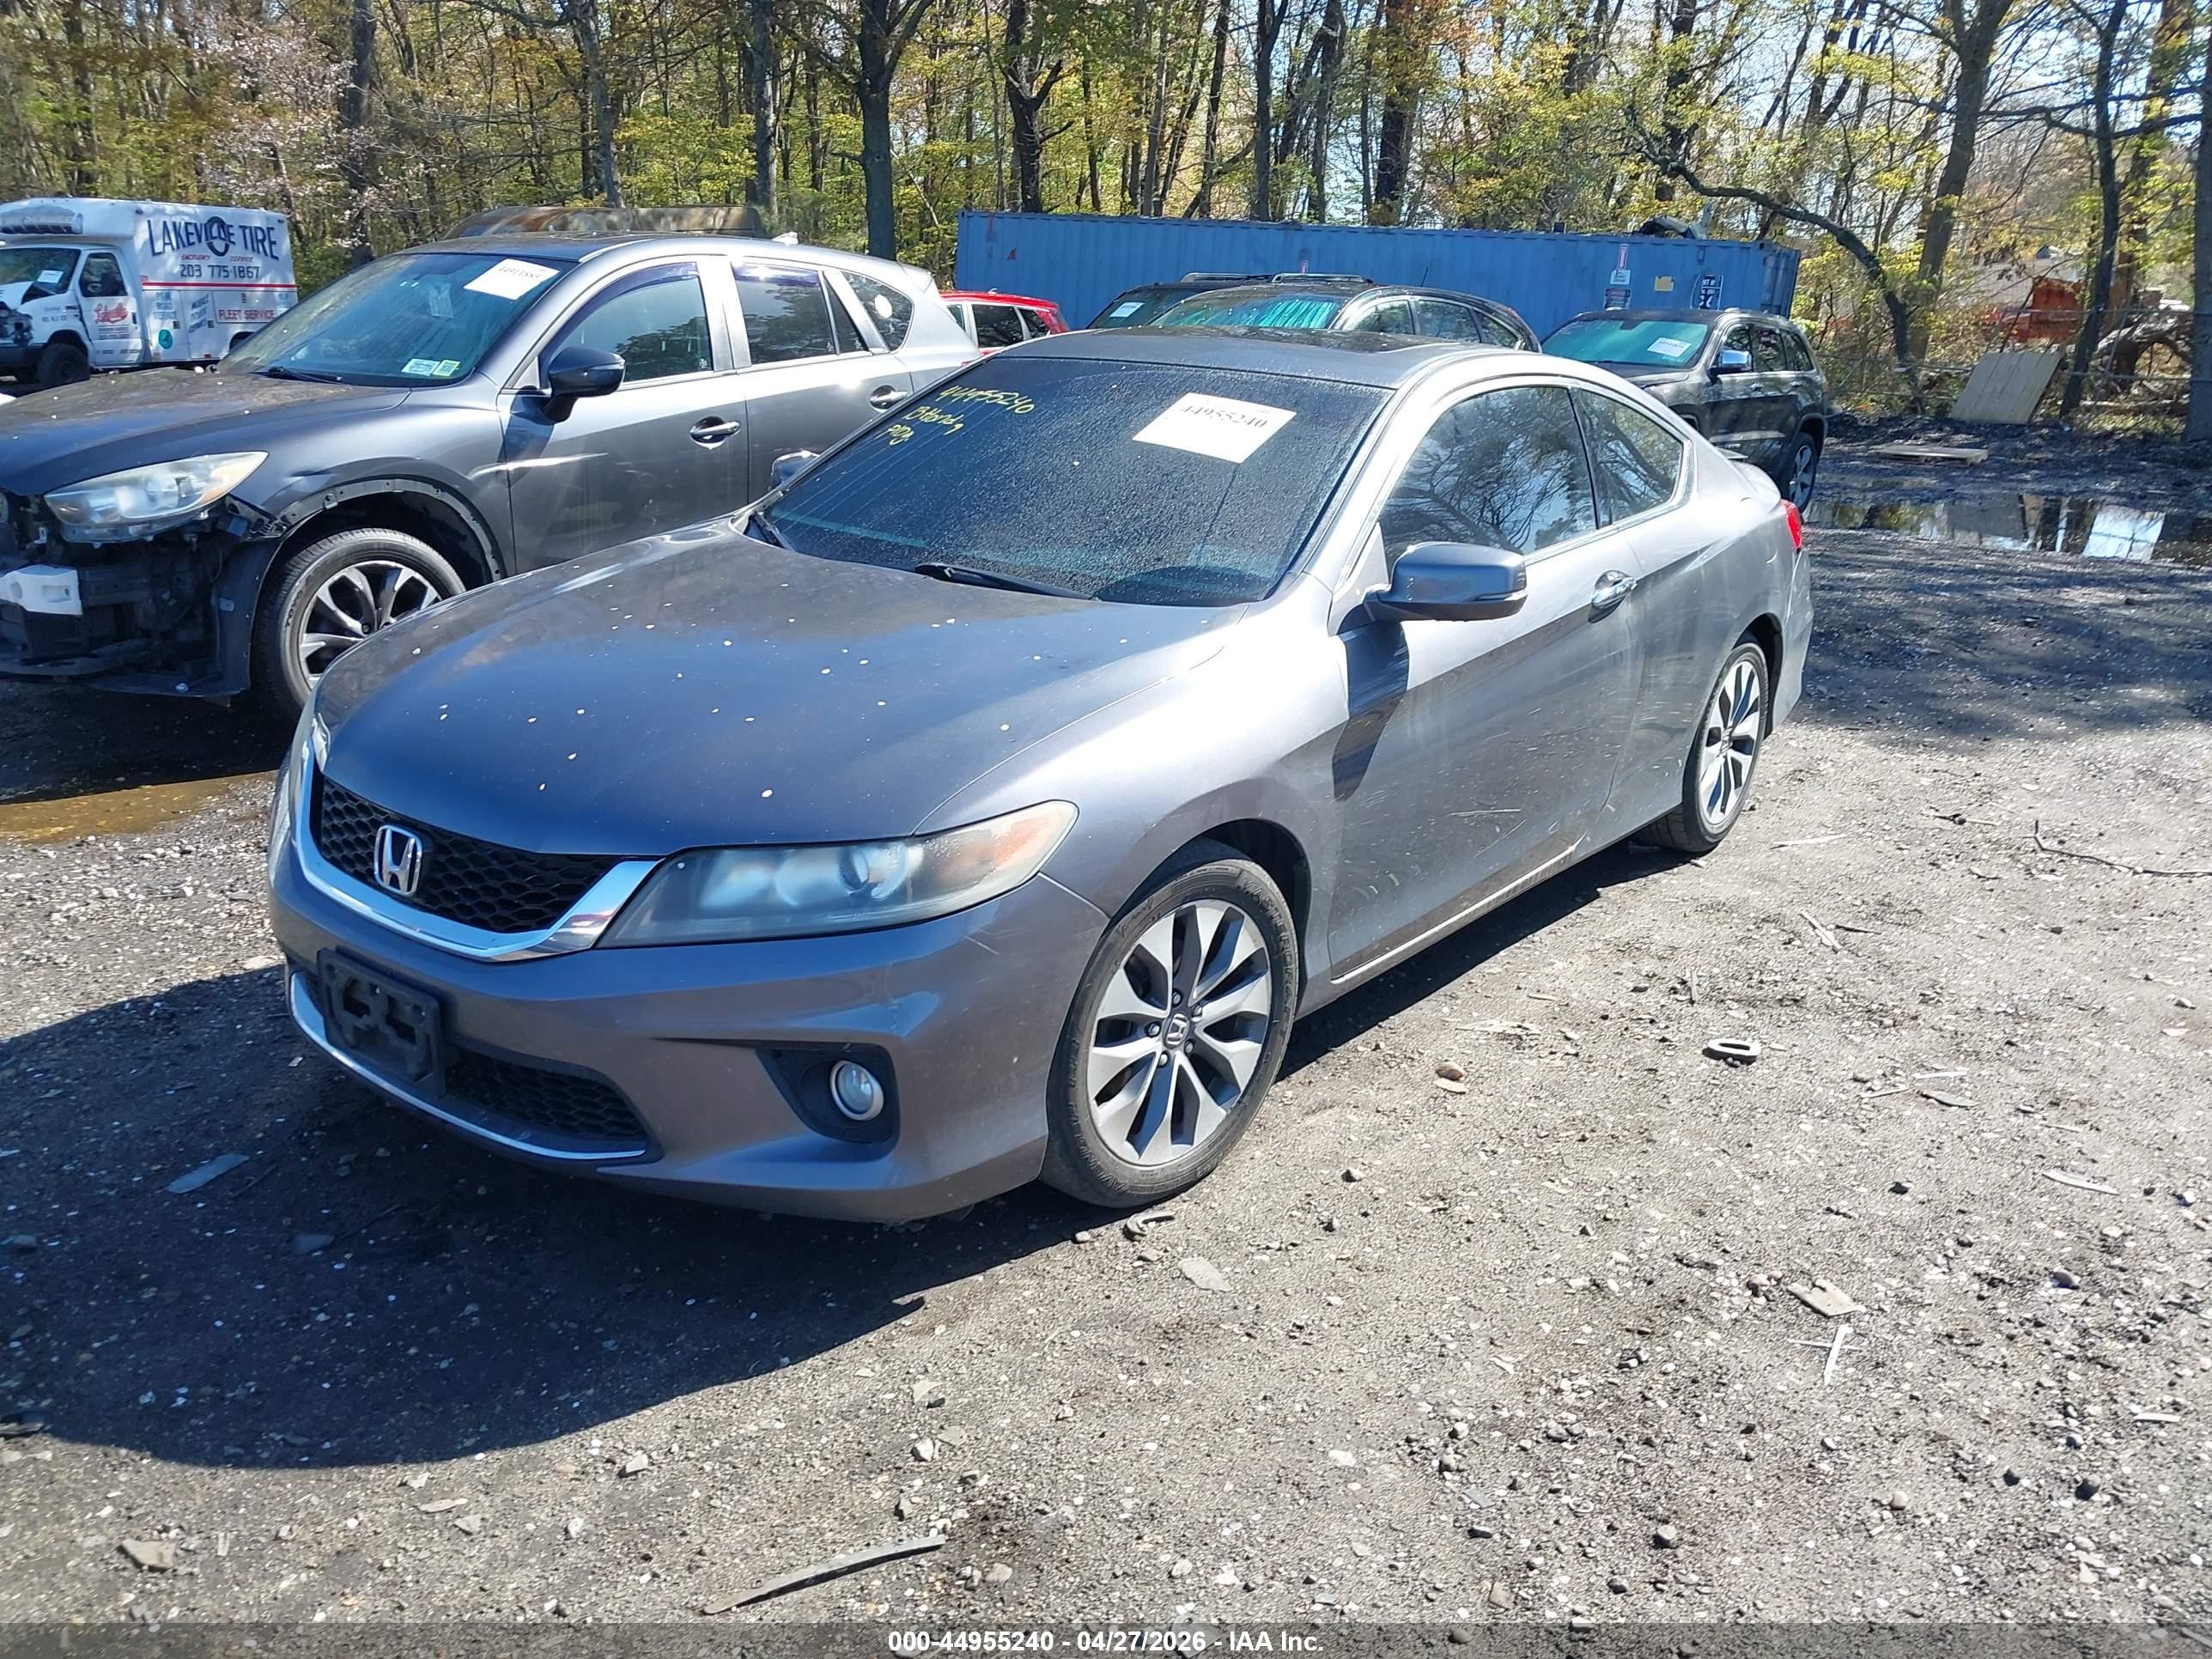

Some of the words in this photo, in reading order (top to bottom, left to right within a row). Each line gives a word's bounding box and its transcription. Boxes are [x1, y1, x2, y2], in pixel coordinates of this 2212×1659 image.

[239, 224, 280, 260] TIRE
[179, 264, 203, 277] 203
[218, 309, 241, 320] FLEET
[244, 310, 276, 320] SERVICE
[935, 386, 1036, 414] 44955240
[1181, 404, 1268, 428] 44955240
